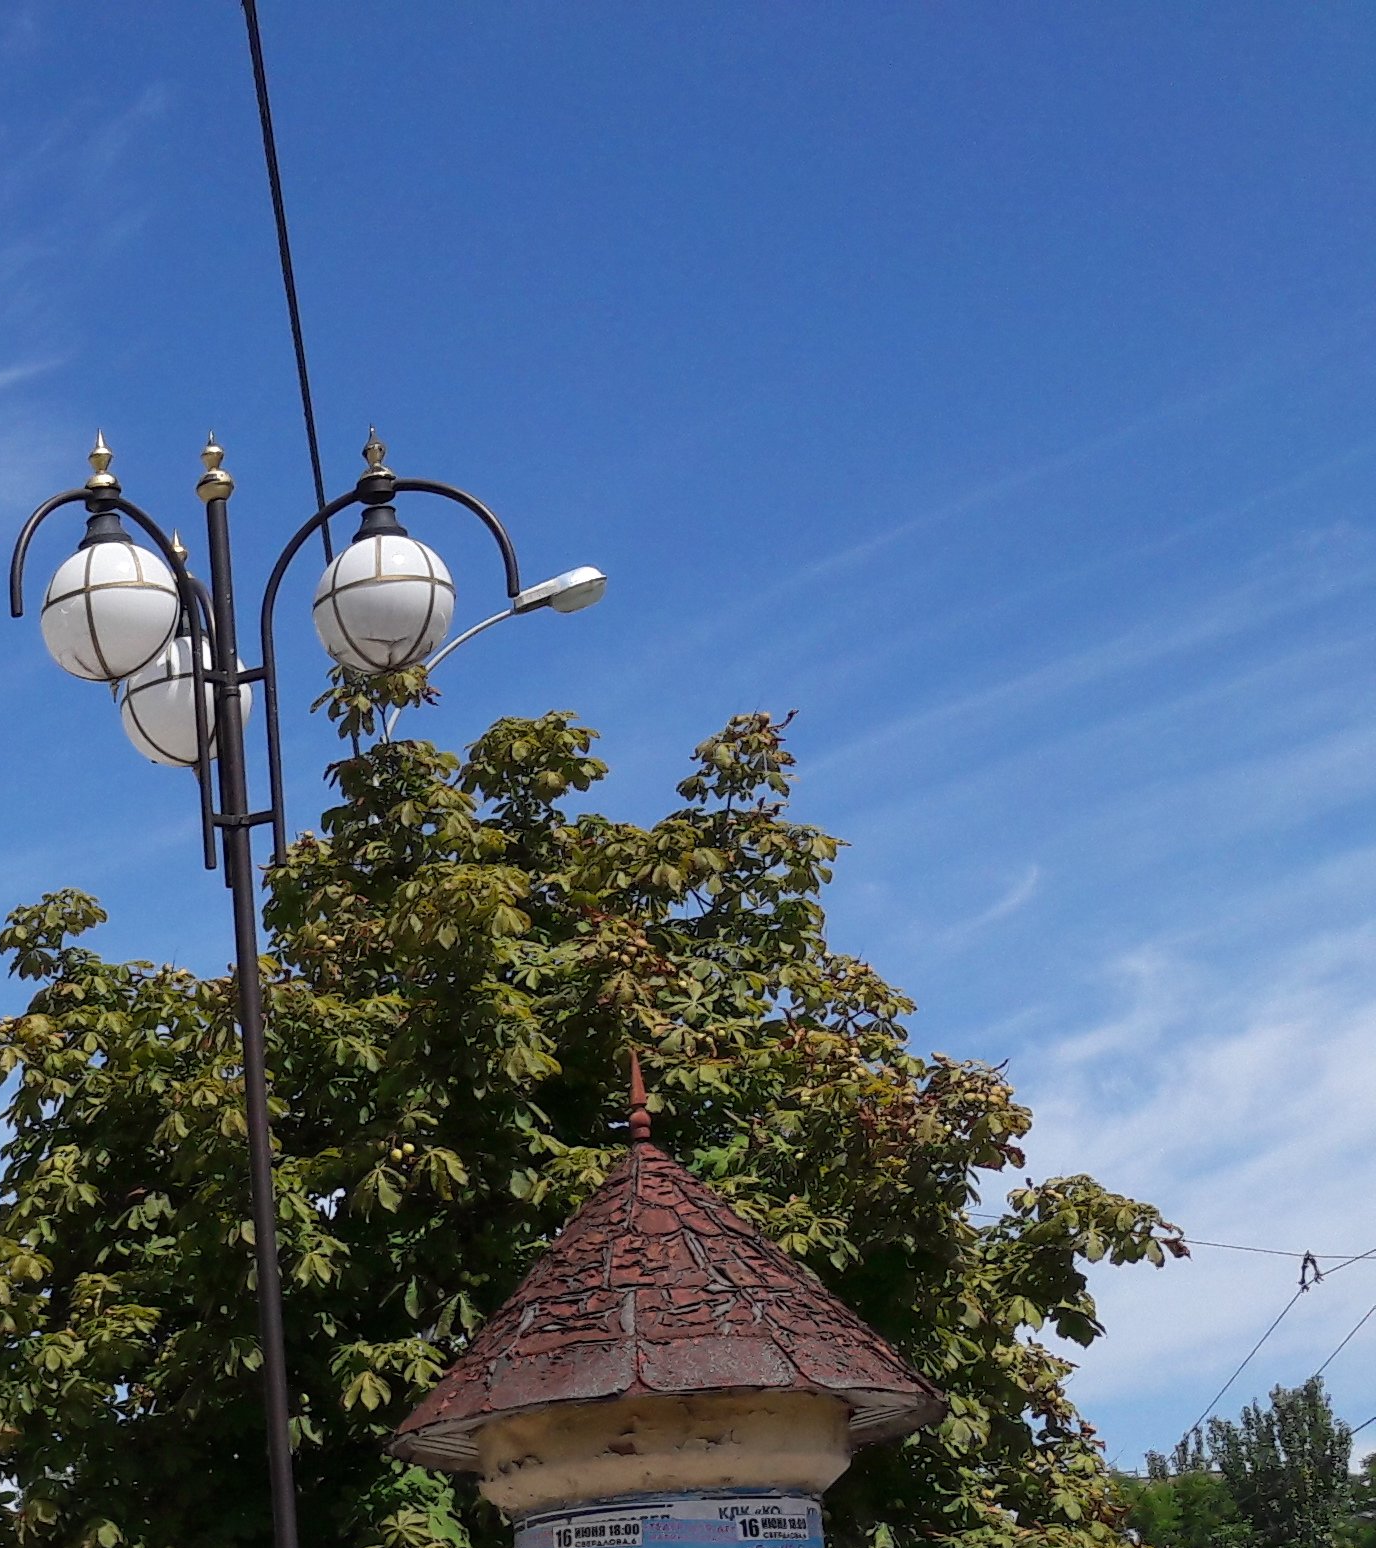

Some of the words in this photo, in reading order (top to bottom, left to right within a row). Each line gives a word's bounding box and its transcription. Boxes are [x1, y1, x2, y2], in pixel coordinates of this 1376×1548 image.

[555, 1528, 572, 1548] 16
[608, 1523, 640, 1536] 18:00
[739, 1518, 760, 1538] 16
